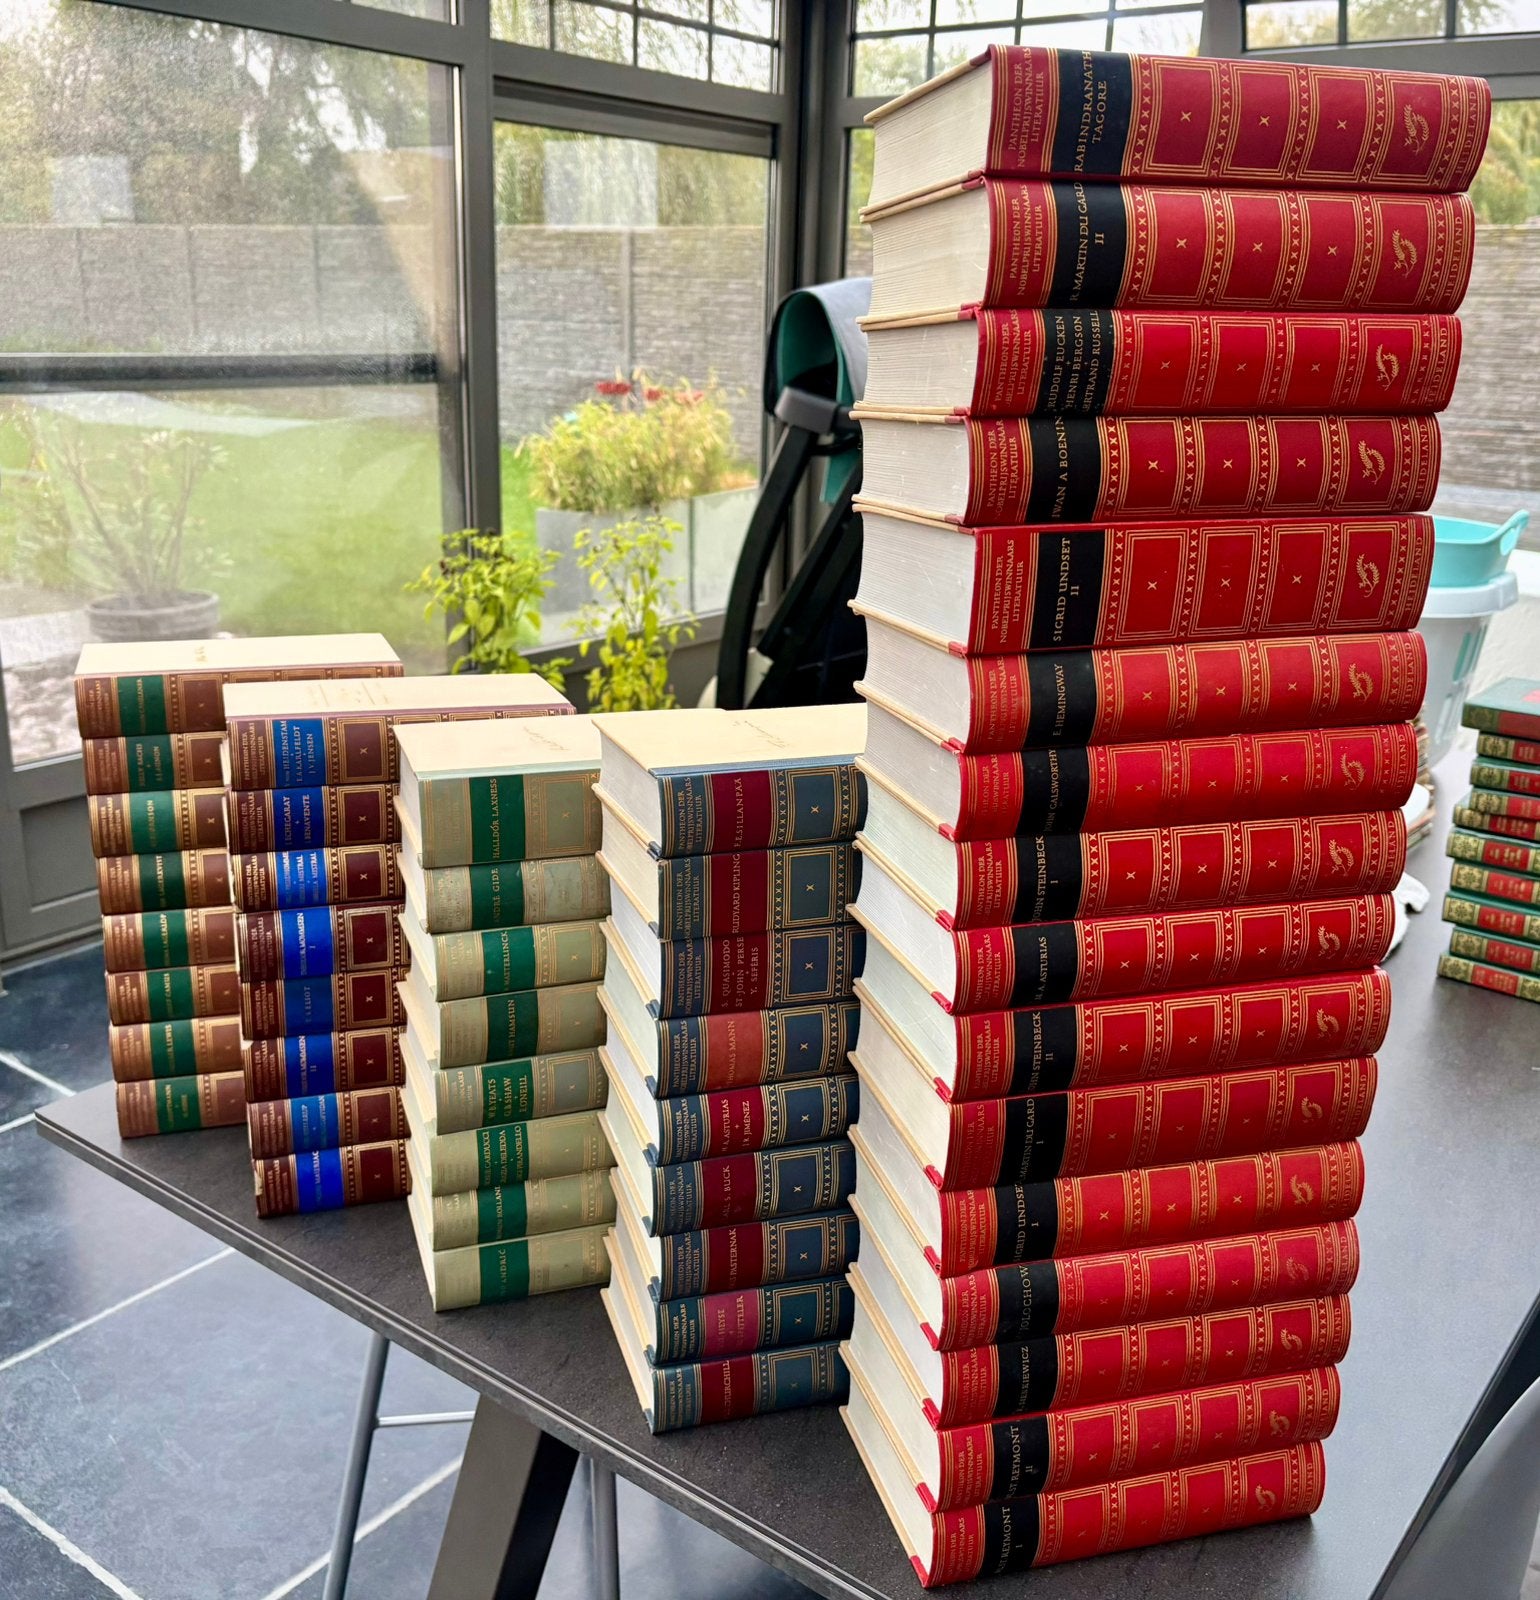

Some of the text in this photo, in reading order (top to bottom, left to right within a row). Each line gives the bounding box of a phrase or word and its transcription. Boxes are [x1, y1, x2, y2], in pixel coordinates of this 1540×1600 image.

[1009, 63, 1023, 150] PANTHEON DER
[1018, 47, 1032, 168] NOBELPRIJSWINNAARS
[1032, 71, 1044, 143] LITERATUUR
[1074, 50, 1092, 173] RABINDRANATH
[1093, 81, 1107, 144] TAGORE
[1010, 219, 1019, 279] PANTHEON
[1018, 184, 1029, 296] NOBELPRIJSWINNAARS
[1033, 204, 1042, 273] LITERATUUR
[1074, 182, 1089, 290] MARTIN DU GARD
[1096, 232, 1105, 245] II
[1445, 216, 1463, 297] HEIDELAND
[994, 323, 1010, 402] PANTHEON DER
[1018, 330, 1032, 395] LITERATUUR
[1048, 315, 1065, 408] RUDOLF EUCKEN
[1065, 316, 1083, 409] HENRI BERGSON
[1091, 310, 1101, 355] RUSSELL
[988, 429, 998, 508] PANTHEON DER
[1010, 436, 1020, 499] LITERATUUR
[1056, 416, 1068, 468] BOENIN
[1415, 423, 1429, 499] HEIDELAND
[1062, 472, 1068, 481] A
[992, 578, 1003, 630] PANTHEON
[1001, 539, 1015, 643] NOBELPRIJSWINNAARS
[1014, 560, 1024, 622] LITERATUUR
[1054, 537, 1071, 642] SIGRID UNDSET
[1072, 585, 1080, 596] II
[1405, 536, 1423, 612] HEIDELAND
[1055, 663, 1067, 727] HEMINGWAY
[281, 720, 290, 770] HEIDENSTAM
[307, 733, 315, 763] JENSEN
[1050, 749, 1060, 810] GALSWORTHY
[490, 778, 500, 859] HALLDÓR LAXNESS
[492, 868, 500, 892] GIDE
[733, 853, 741, 892] KIPLING
[994, 859, 1003, 908] LITERATUUR
[1033, 835, 1047, 922] JOHN STEINBECK
[723, 939, 731, 996] QUASIMODO
[737, 937, 745, 965] PERSE
[1039, 936, 1048, 983] ASTURIAS
[508, 999, 516, 1038] HAMSUN
[1033, 1011, 1042, 1071] STEINBECK
[673, 1048, 681, 1087] PANTHEON
[728, 1021, 736, 1085] THOMAS MANN
[1046, 1052, 1054, 1061] II
[722, 1099, 731, 1139] ASTURIAS
[1026, 1127, 1034, 1144] DU
[723, 1165, 732, 1192] BUCK
[1023, 1144, 1033, 1180] MARTIN
[1016, 1184, 1026, 1228] UNDSE
[730, 1228, 739, 1276] PASTERNAK
[1012, 1426, 1022, 1481] REYMONT
[1002, 1506, 1011, 1561] REYMONT
